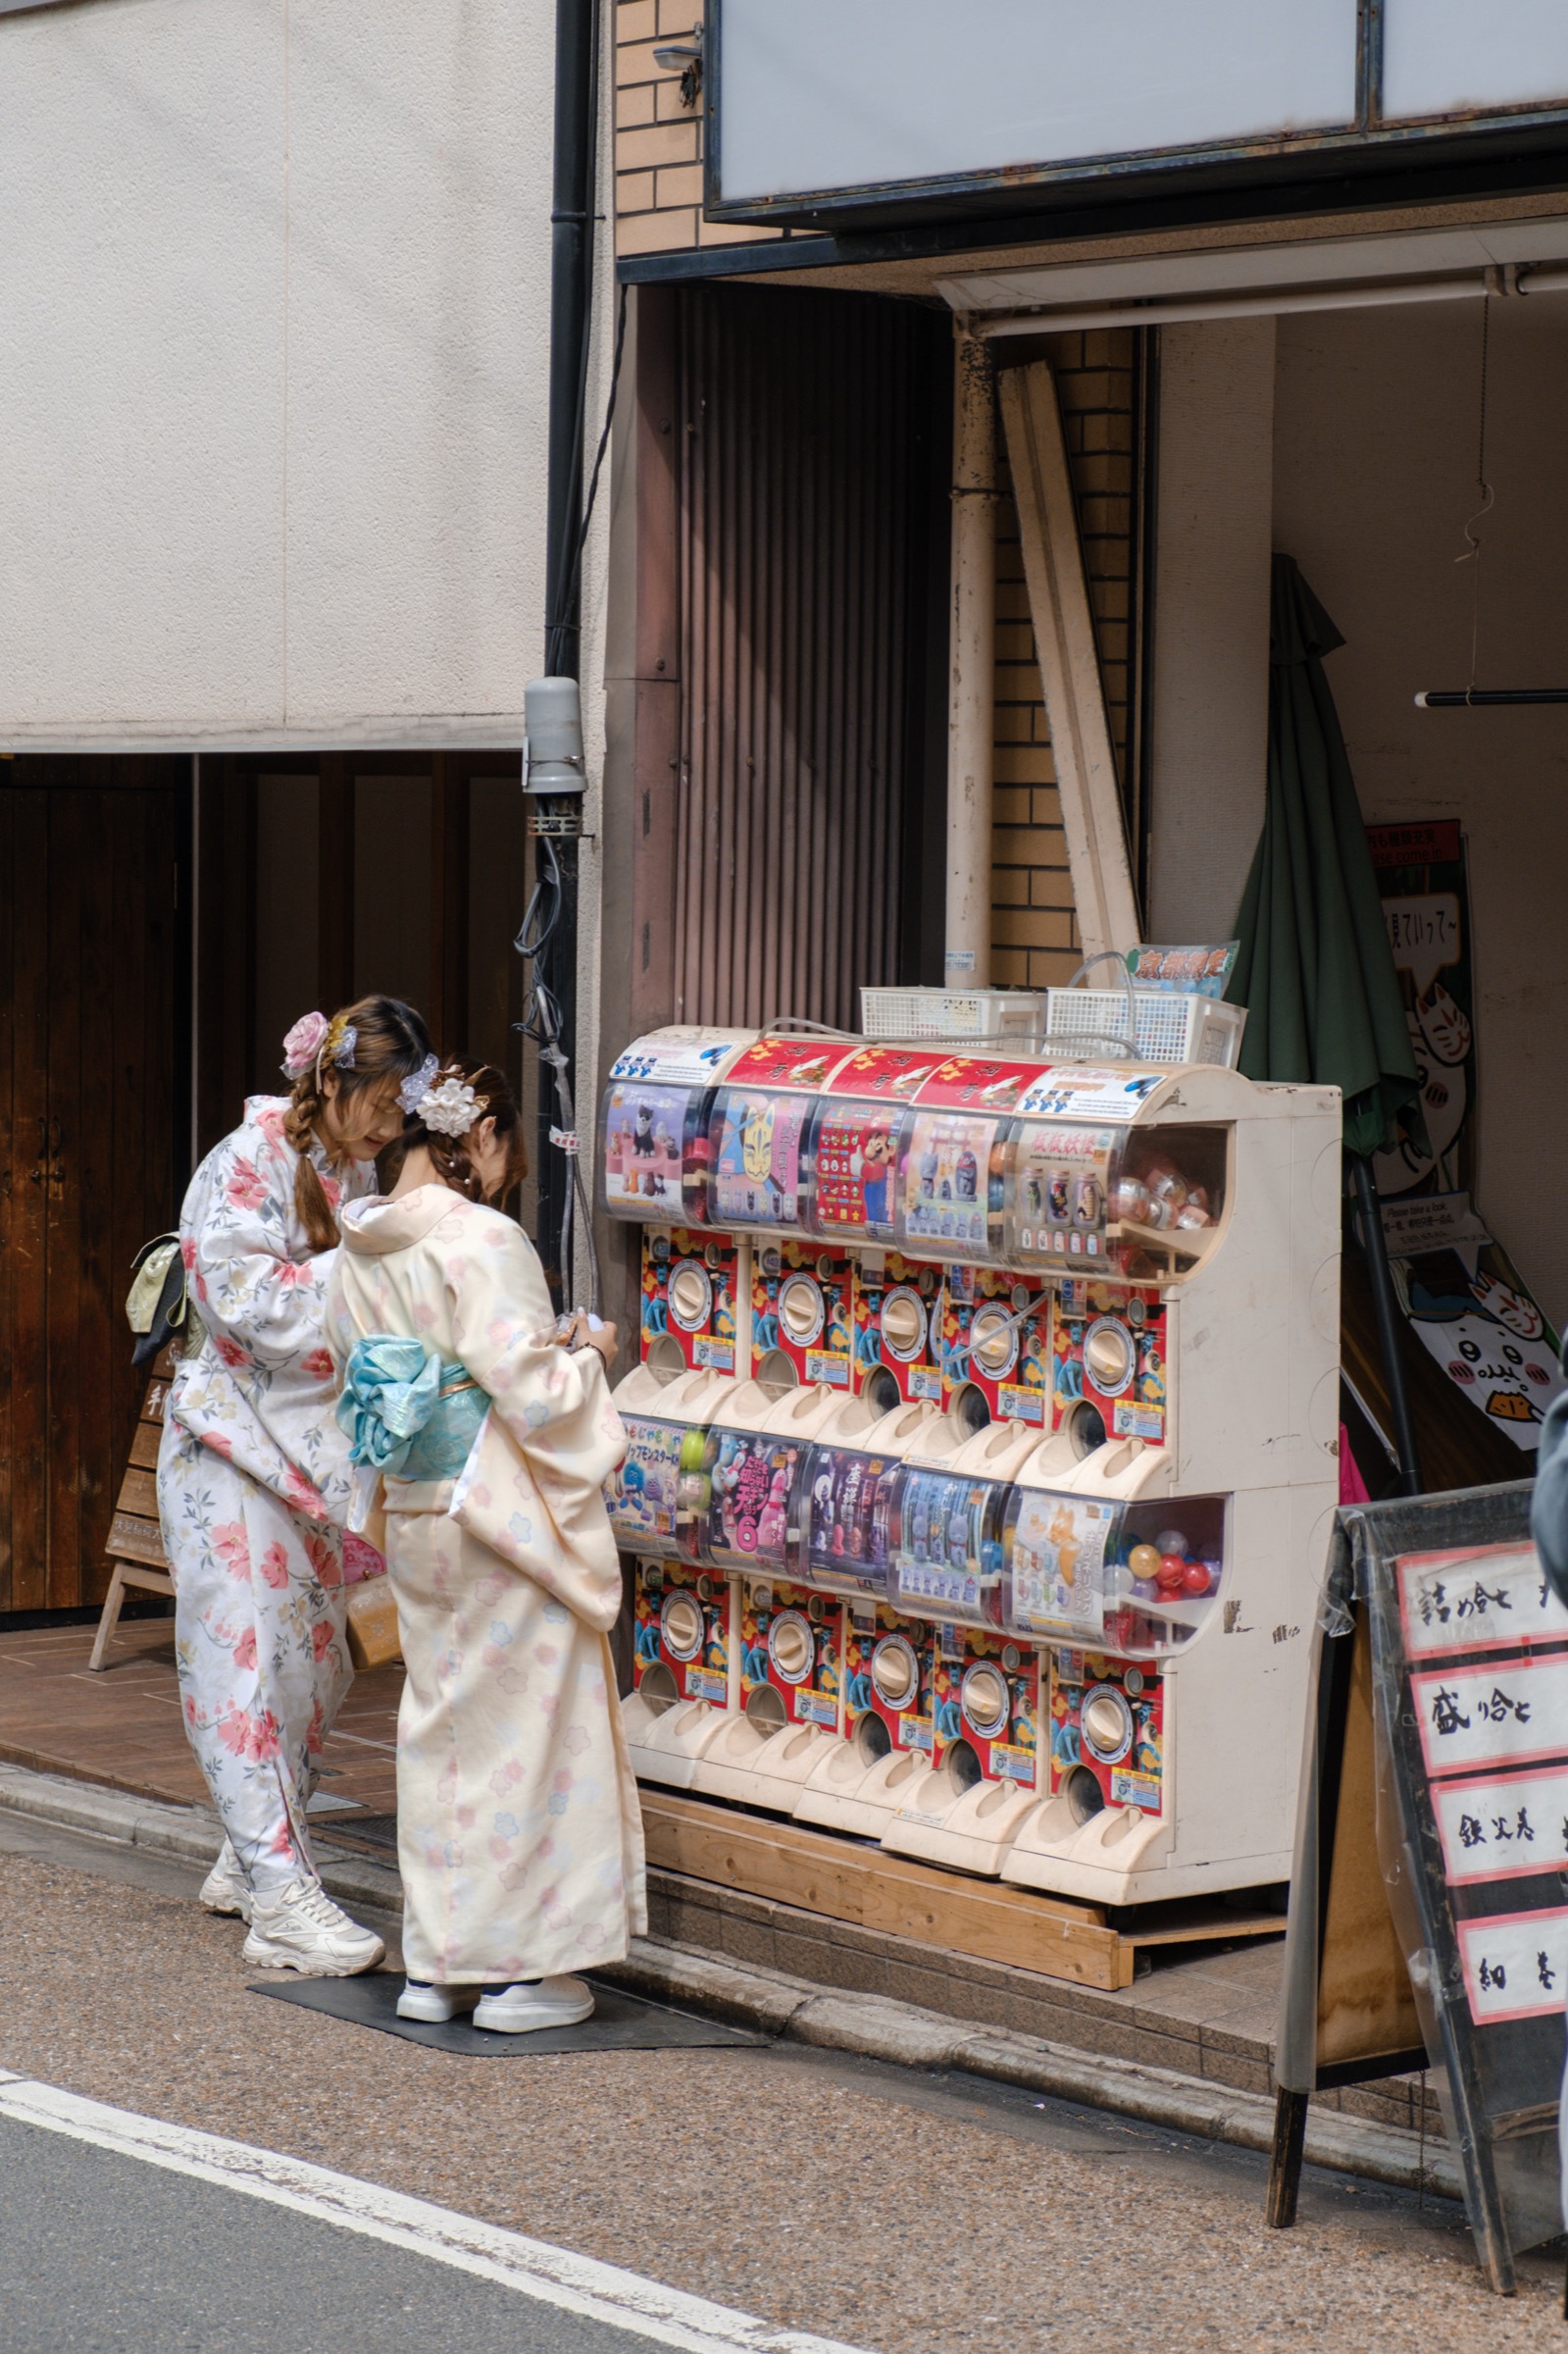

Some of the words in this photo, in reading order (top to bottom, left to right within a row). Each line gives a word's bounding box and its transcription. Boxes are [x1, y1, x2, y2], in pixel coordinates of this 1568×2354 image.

[1373, 852, 1392, 865] ase
[1396, 850, 1429, 863] come
[1433, 846, 1443, 860] in
[736, 1515, 758, 1552] 6
